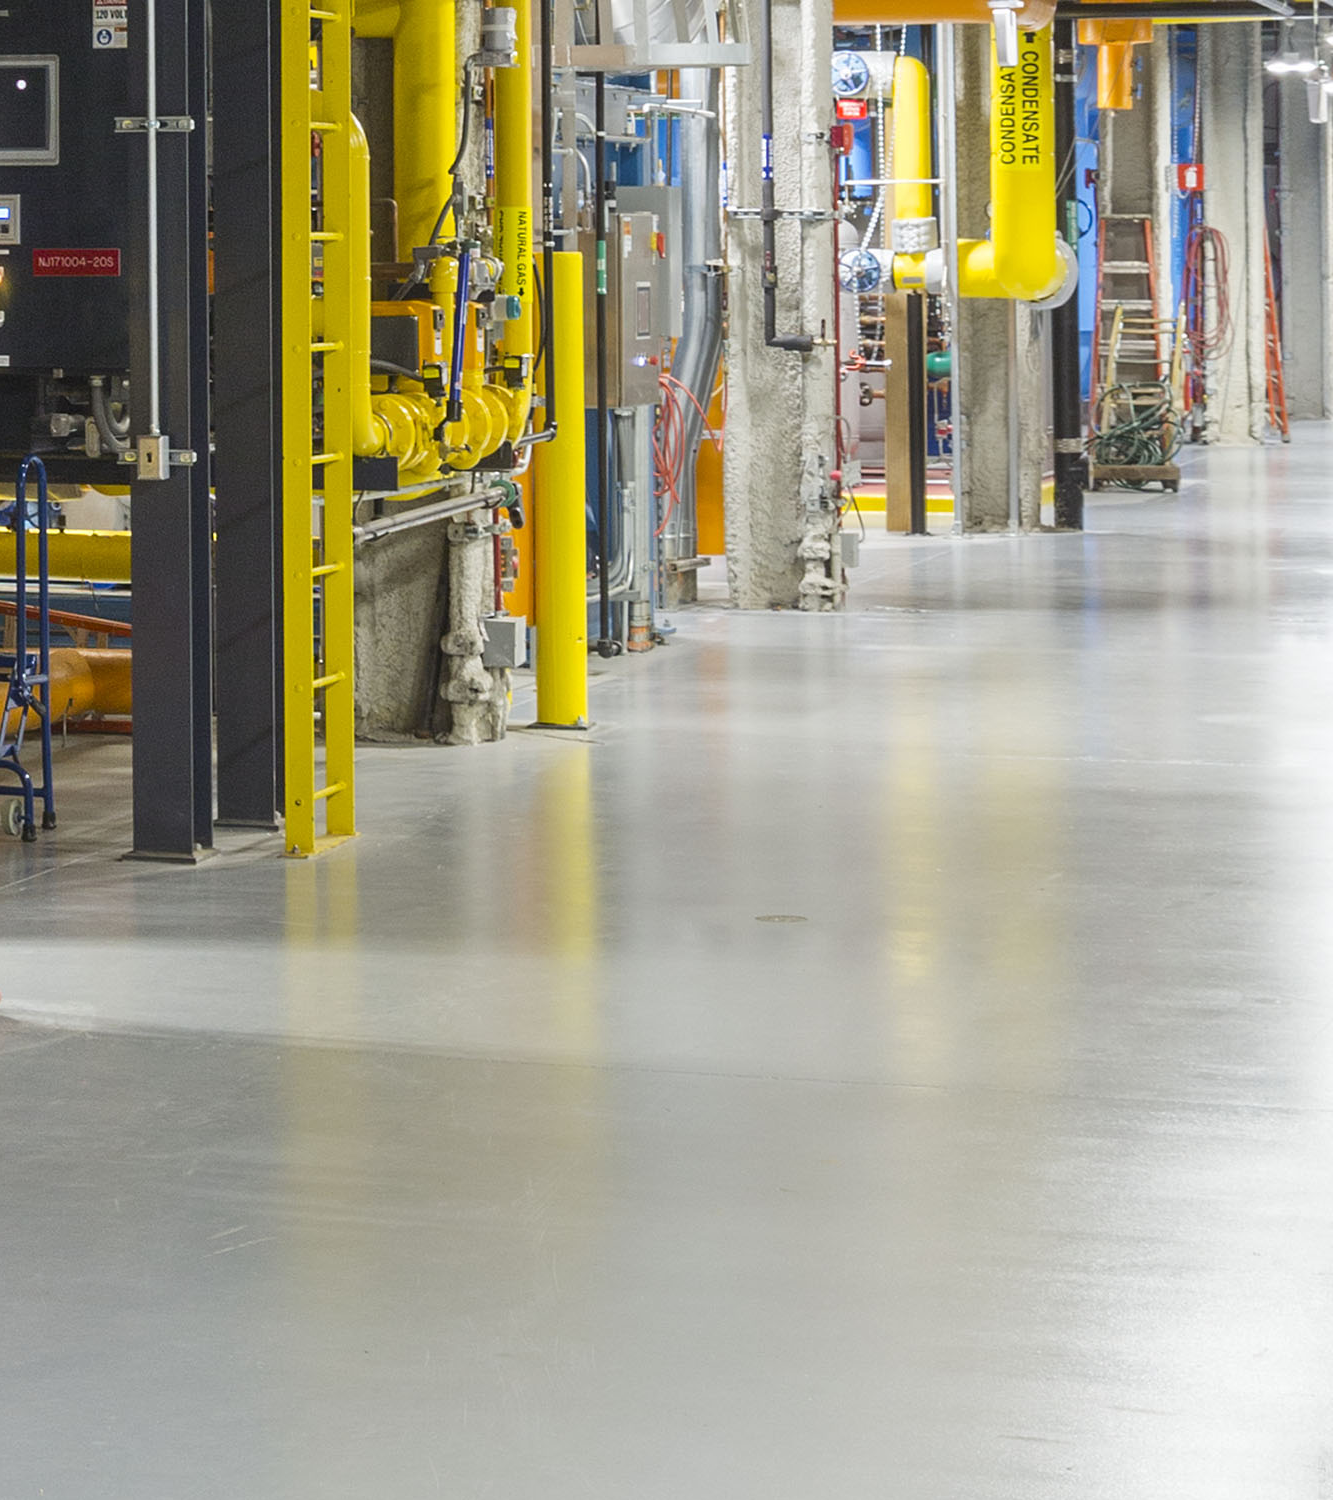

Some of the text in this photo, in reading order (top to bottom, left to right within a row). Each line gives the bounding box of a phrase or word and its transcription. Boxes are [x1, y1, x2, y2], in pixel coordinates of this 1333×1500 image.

[95, 9, 108, 20] 120
[999, 65, 1017, 165] CONDENSAT
[1020, 50, 1040, 165] CONDENSATE
[38, 256, 114, 268] NJ171004-20S
[516, 211, 528, 286] NATURAL GAS
